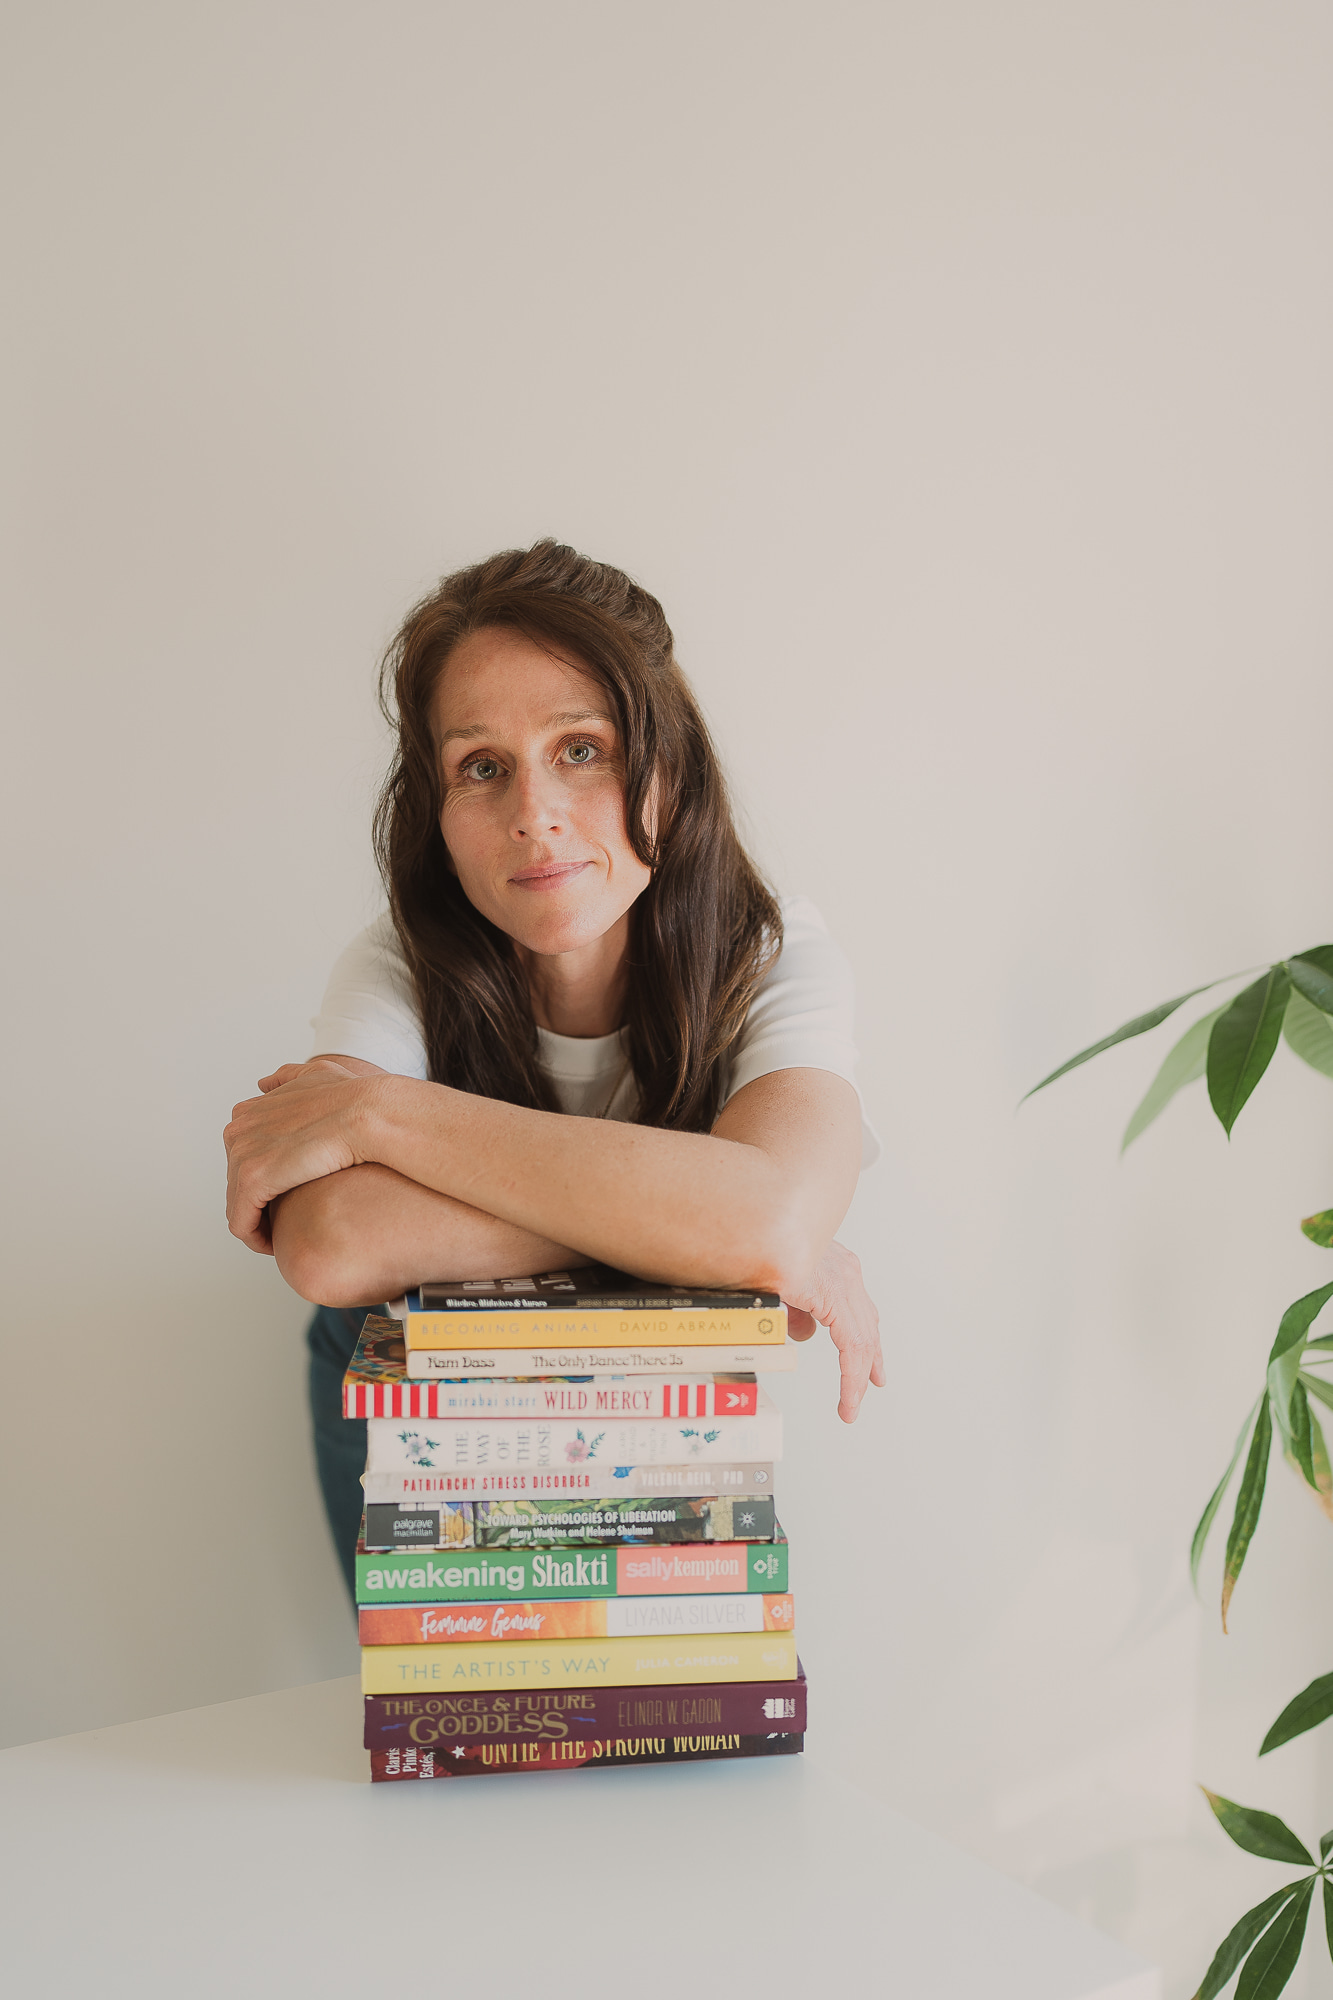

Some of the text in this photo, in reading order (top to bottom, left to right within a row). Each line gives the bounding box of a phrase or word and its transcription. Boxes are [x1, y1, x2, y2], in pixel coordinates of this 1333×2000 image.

[421, 1320, 731, 1335] BECOMING ANIMAL DAVID ABRAM
[428, 1353, 684, 1370] Ram Dass The Only Dance There Is
[448, 1392, 537, 1408] mirabai starr
[544, 1390, 653, 1410] WILD MERCY
[455, 1431, 469, 1465] THE
[476, 1429, 490, 1465] WAY
[497, 1438, 510, 1460] OF
[516, 1429, 531, 1464] THE
[537, 1423, 551, 1468] ROSE
[403, 1474, 590, 1492] PATRIARCHY STRESS DISORDER
[641, 1471, 684, 1487] VALERIE
[393, 1519, 434, 1531] palgrave
[487, 1510, 677, 1527] TOWARD PSYCHOLOGIES OF LIBERATION
[393, 1529, 434, 1538] macmillan
[510, 1524, 654, 1540] Mary Watkins and Helene Shulman
[365, 1553, 609, 1592] awakening Shakti
[419, 1606, 546, 1642] Feminine Genius
[625, 1602, 747, 1628] LIYANA SILVER
[398, 1657, 611, 1680] THE ARTIST'S WAY
[634, 1655, 739, 1672] JULIA CAMERON
[381, 1694, 596, 1717] THE ONCE & FUTURE
[618, 1700, 663, 1728] ELINOR
[682, 1697, 722, 1724] GADON
[408, 1711, 569, 1744] GODDESS
[592, 1735, 665, 1759] STRONG
[673, 1733, 741, 1753] WOMAN
